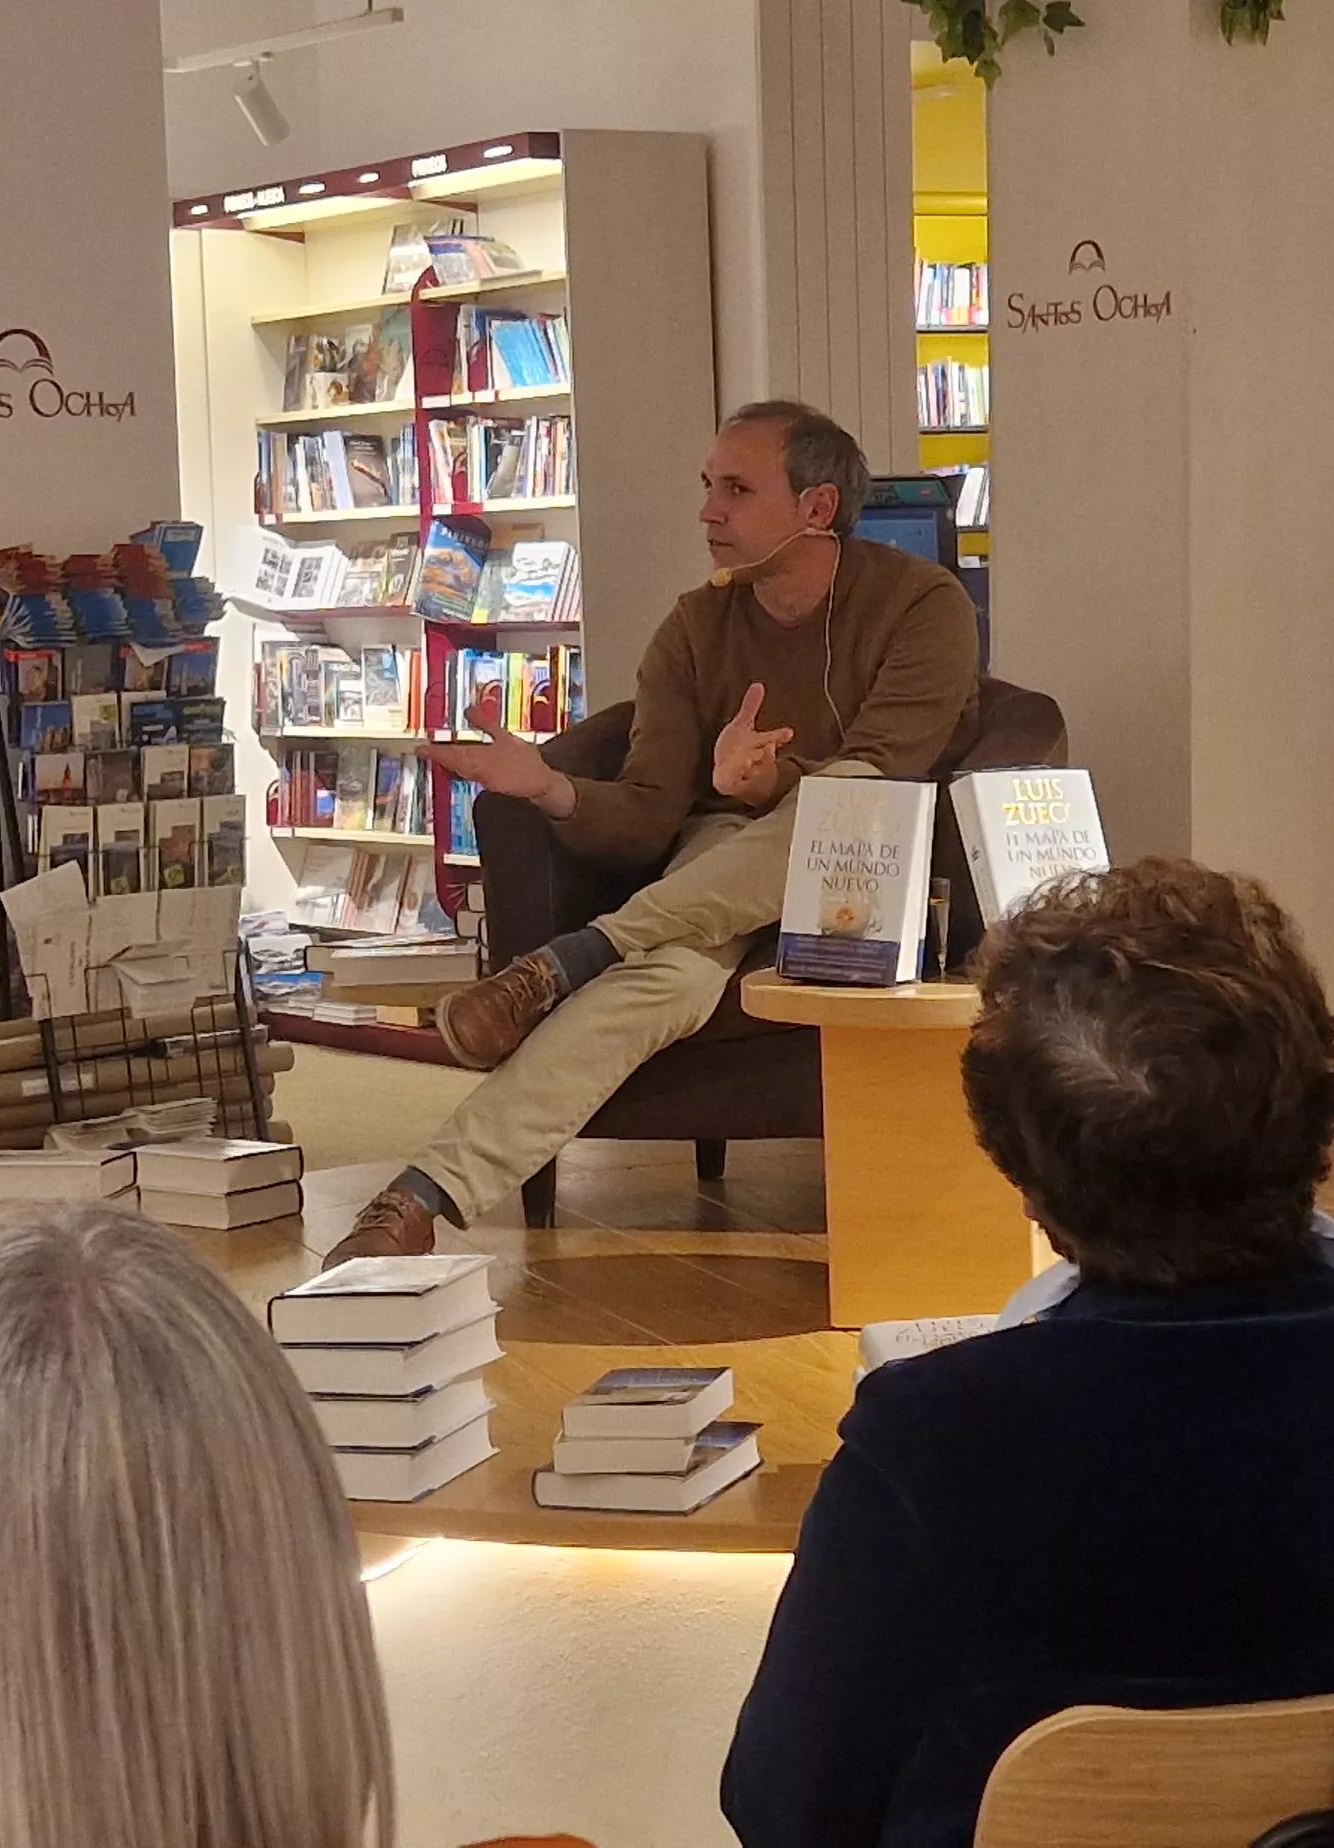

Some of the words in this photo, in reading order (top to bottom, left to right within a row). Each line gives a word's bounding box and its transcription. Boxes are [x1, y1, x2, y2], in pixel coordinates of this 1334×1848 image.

[1012, 778, 1064, 801] LUIS
[1025, 830, 1069, 846] MAPA
[1072, 830, 1092, 845] DE
[810, 840, 824, 854] EL
[829, 841, 874, 858] MAPA
[879, 843, 901, 860] DE
[1007, 850, 1033, 863] UN
[1035, 847, 1097, 863] MUNDO
[807, 857, 832, 872] UN
[834, 858, 900, 878] MUNDO
[821, 875, 879, 894] NUEVO
